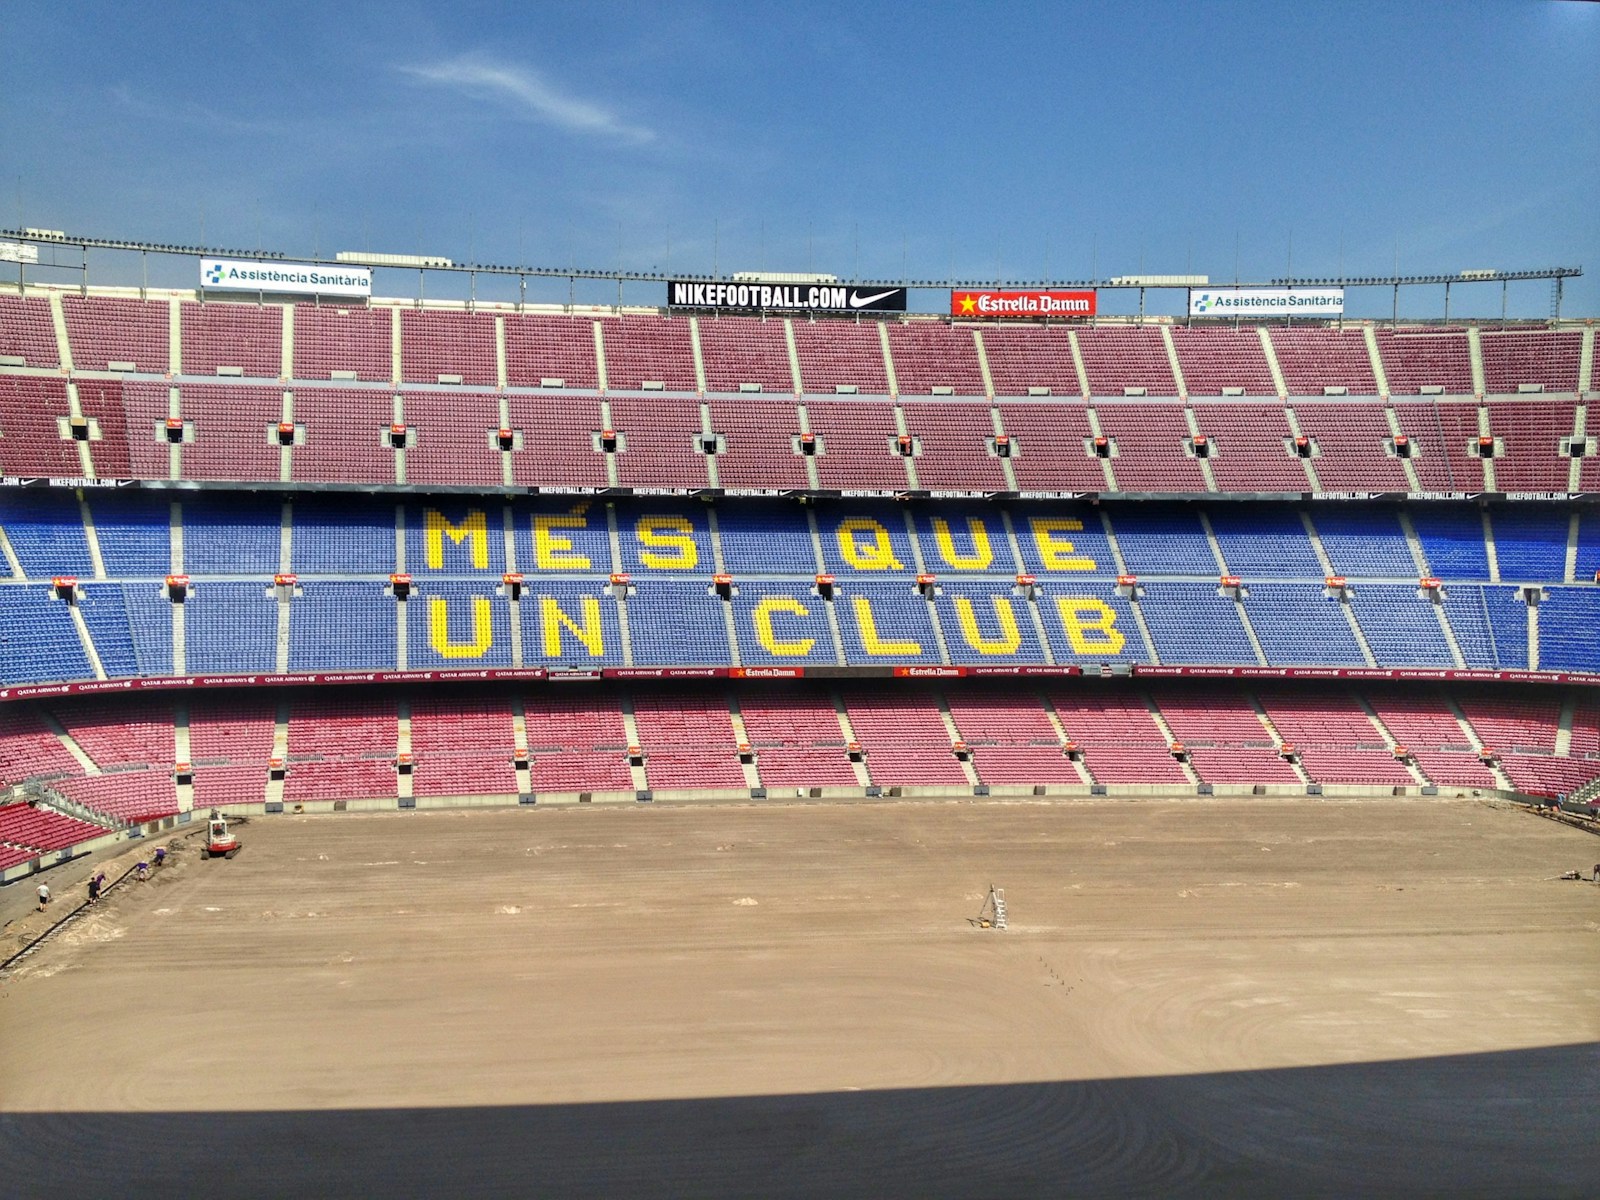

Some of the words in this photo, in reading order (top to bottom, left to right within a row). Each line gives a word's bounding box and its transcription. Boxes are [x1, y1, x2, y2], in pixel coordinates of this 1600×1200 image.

[229, 268, 307, 283] Assistència
[310, 273, 369, 287] Sanitària
[674, 283, 846, 309] NIKEFOOTBALL.COM
[978, 293, 1038, 312] Estrella
[1039, 295, 1089, 312] Damm
[1215, 296, 1286, 307] Assistència
[1288, 295, 1343, 306] Sanitària
[49, 478, 116, 487] NIKEFOOTBALL.COM
[538, 487, 594, 495] NIKEFOOTBALL.COM
[724, 489, 778, 497] NIKEFOOTBALL.COM
[930, 490, 983, 498] NIKEFOOTBALL.COM
[1020, 491, 1072, 499] NIKEFOOTBALL.COM
[1312, 492, 1368, 500] NIKEFOOTBALL.COM
[1407, 492, 1465, 500] NIKEFOOTBALL.COM
[1506, 492, 1567, 500] NIKEFOOTBALL.COM
[424, 501, 697, 569] MÉS
[835, 516, 1096, 570] QUE
[427, 595, 603, 658] UN
[751, 595, 1125, 655] CLUB
[773, 669, 795, 677] Damm
[909, 668, 937, 676] Estrella
[937, 668, 959, 676] Damm
